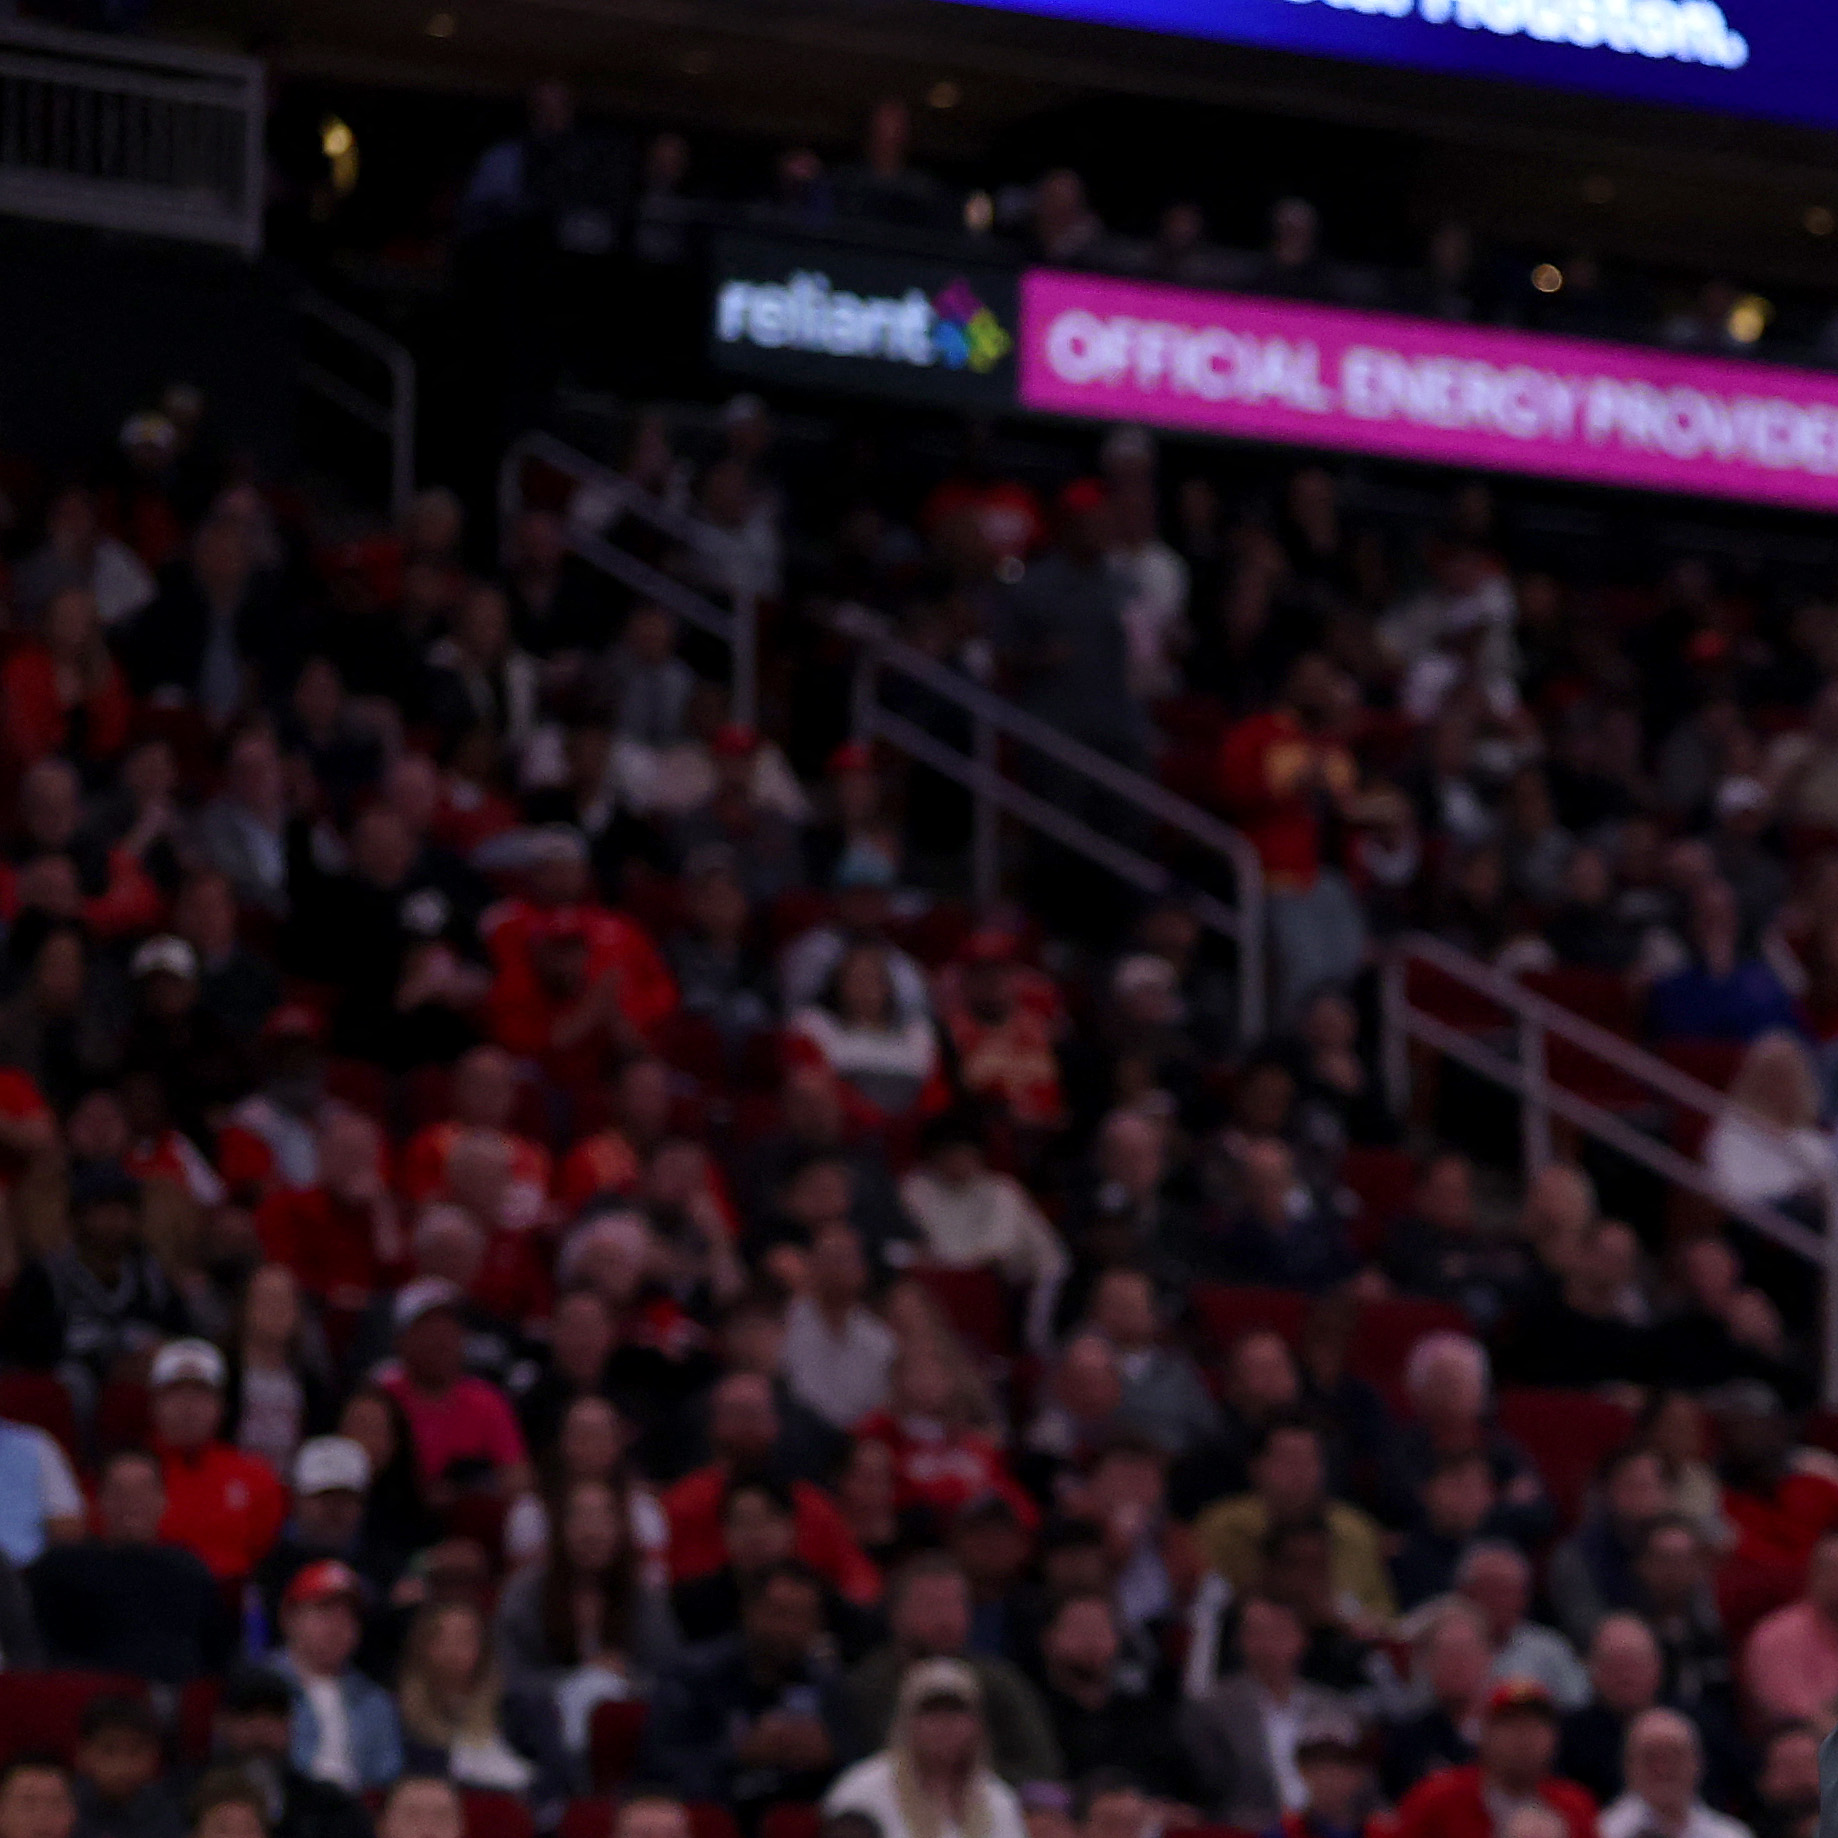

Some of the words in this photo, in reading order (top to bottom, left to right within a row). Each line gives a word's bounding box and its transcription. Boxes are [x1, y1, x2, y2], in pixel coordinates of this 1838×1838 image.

[716, 268, 938, 367] reliant
[1046, 308, 1332, 414] OFFICIAL
[1338, 346, 1575, 440] ENERGY
